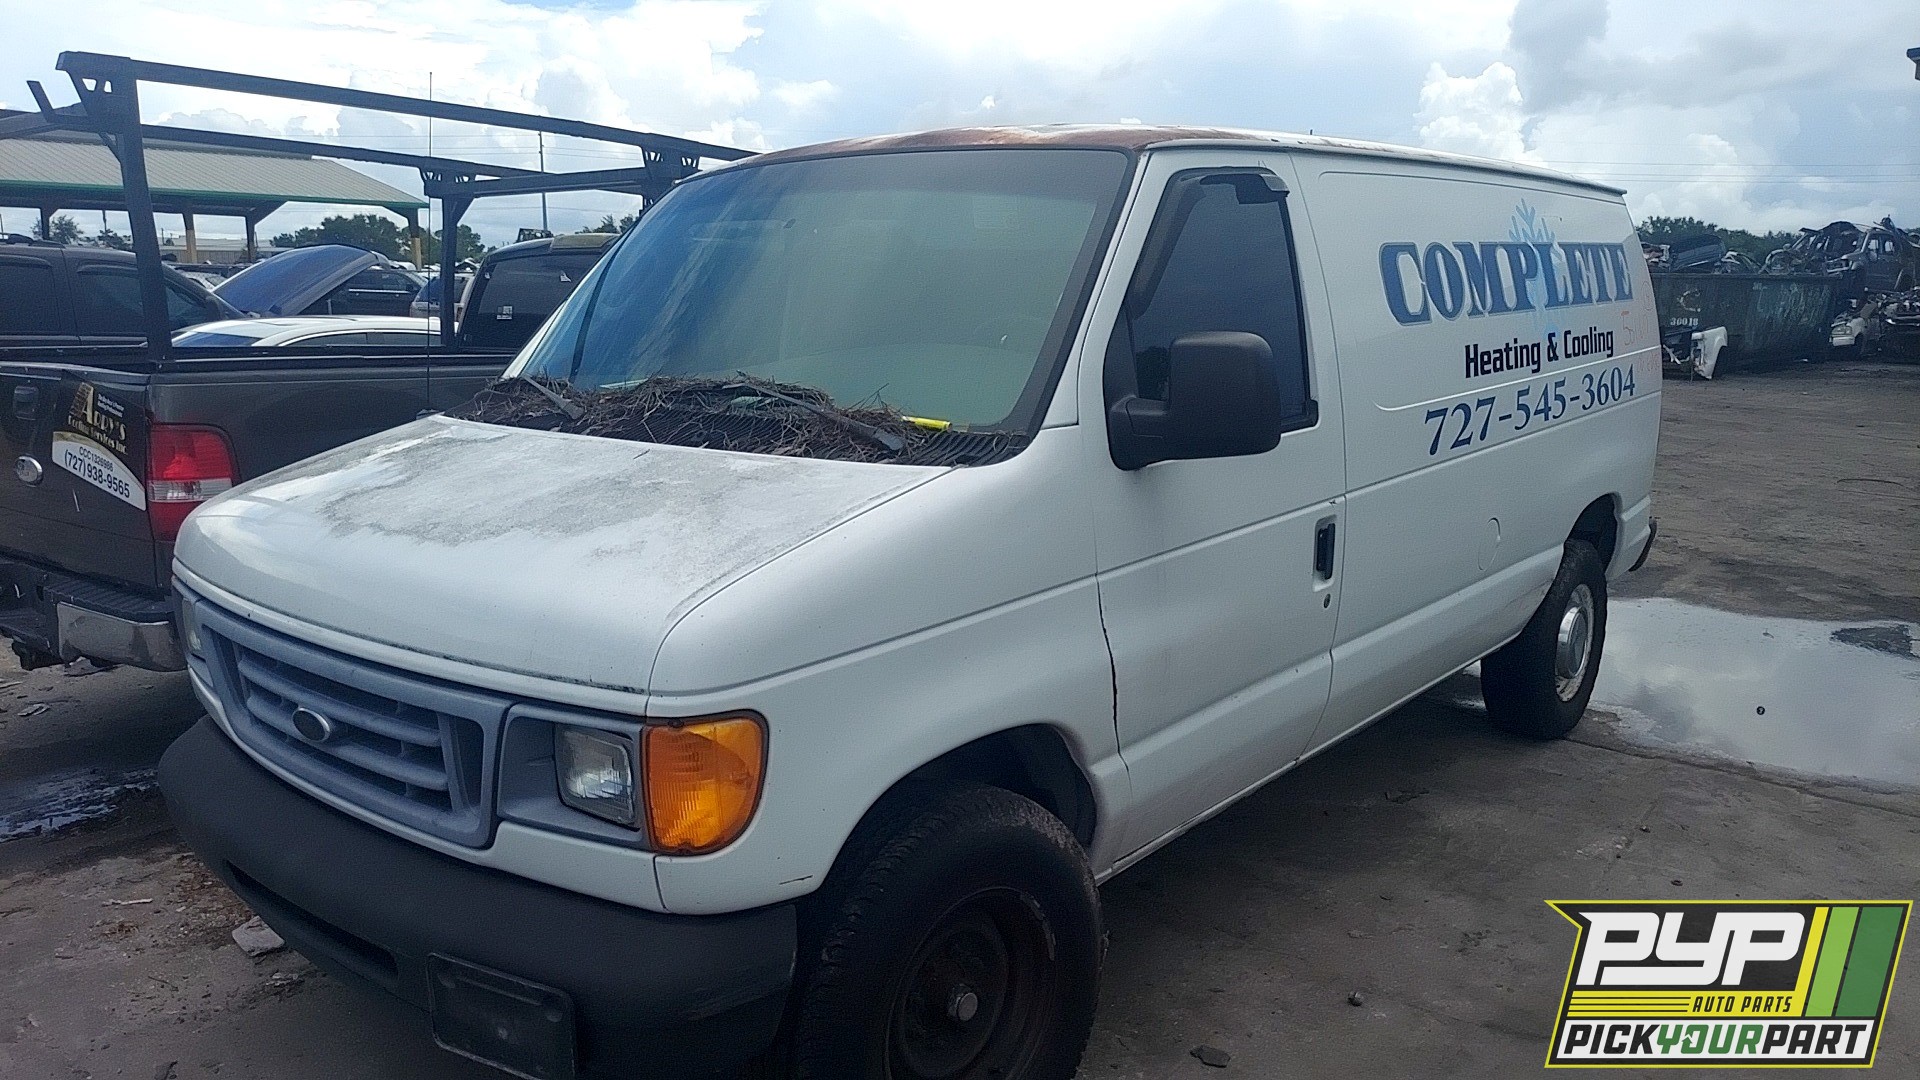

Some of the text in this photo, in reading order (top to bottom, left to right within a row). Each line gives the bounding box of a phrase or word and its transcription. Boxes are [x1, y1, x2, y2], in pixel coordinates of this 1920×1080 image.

[1379, 241, 1634, 327] COMPLETE
[1465, 338, 1541, 379] Heating
[1547, 332, 1560, 362] &
[1563, 326, 1614, 359] Cooling
[1424, 364, 1636, 456] 727-545-3604
